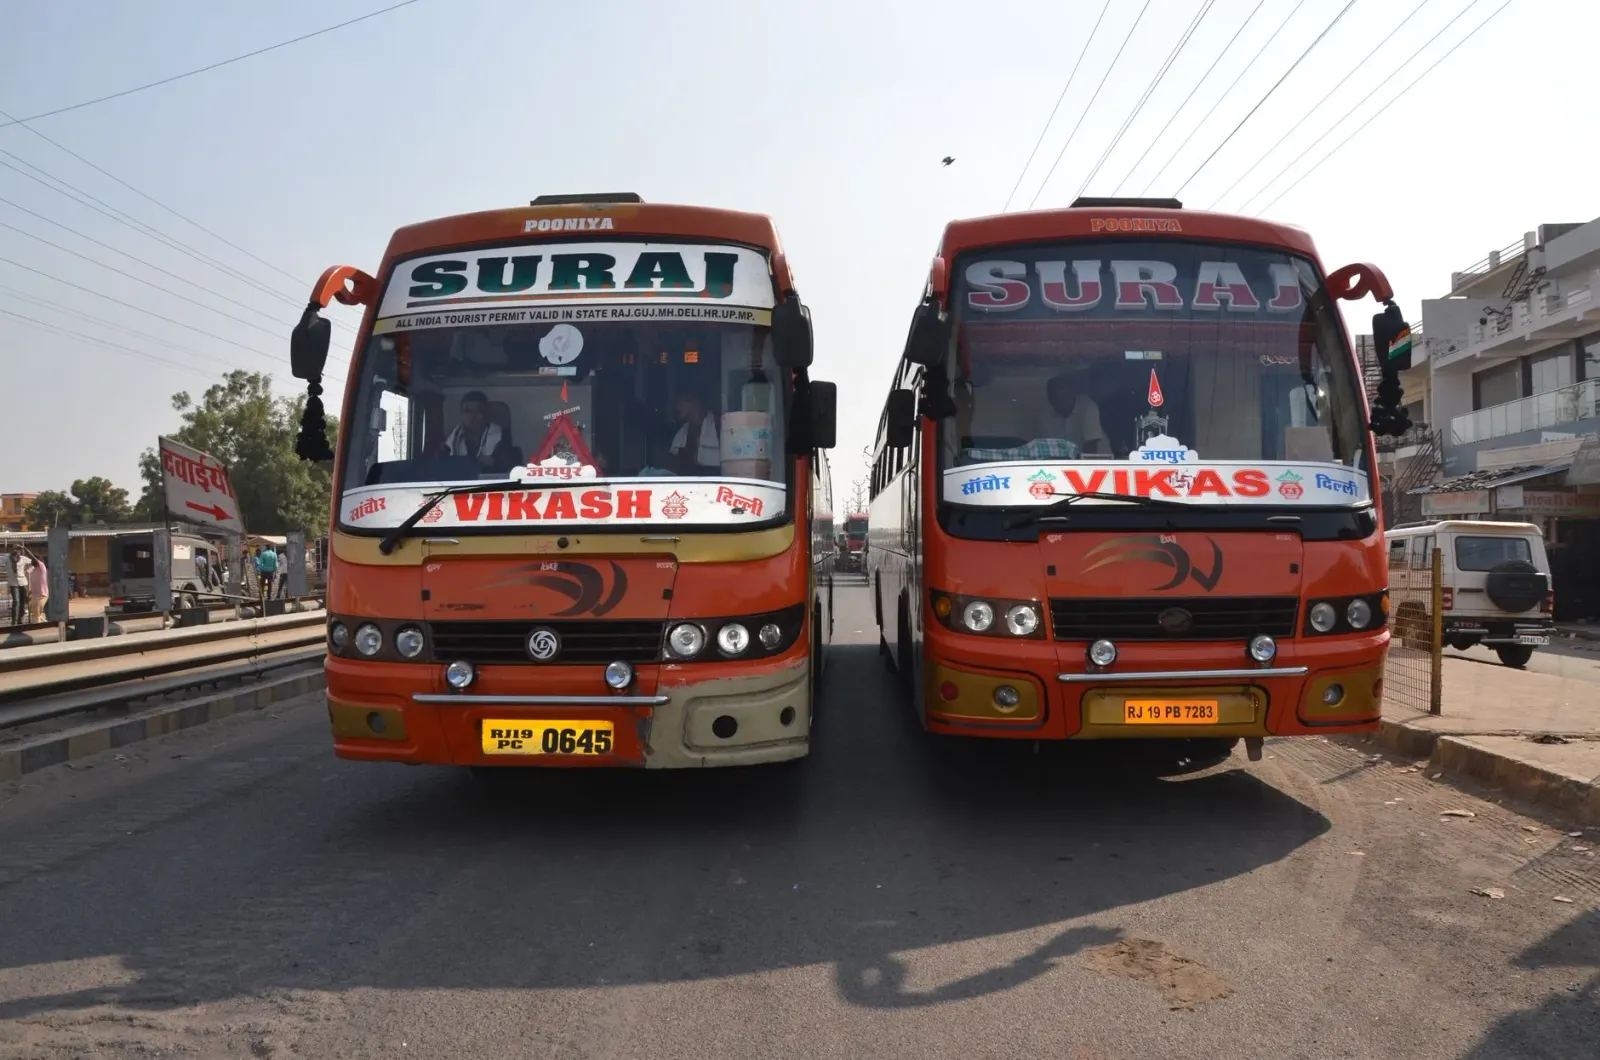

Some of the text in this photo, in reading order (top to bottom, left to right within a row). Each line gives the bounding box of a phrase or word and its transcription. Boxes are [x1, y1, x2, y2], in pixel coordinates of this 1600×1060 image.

[523, 216, 614, 233] POONIYA
[1091, 217, 1183, 232] POONIYA
[408, 250, 739, 299] SURAJ
[965, 259, 1306, 312] SURAJ
[395, 318, 413, 329] ALL
[415, 315, 442, 327] INDIA
[444, 313, 486, 325] TOURIST
[489, 311, 526, 322] PERMIT
[530, 310, 559, 320] VALID
[562, 309, 573, 319] IN
[576, 309, 608, 319] STATE
[1141, 450, 1187, 464] जयपुर
[526, 466, 583, 480] जयपुर
[1061, 469, 1271, 498] VIKAS
[1315, 473, 1359, 497] दिल्ली
[453, 489, 652, 522] VIKASH
[715, 486, 763, 517] दिल्ली
[1128, 706, 1213, 719] RJ 19 PB 7283
[490, 728, 612, 753] RJ19 0645
[497, 740, 523, 749] PC
